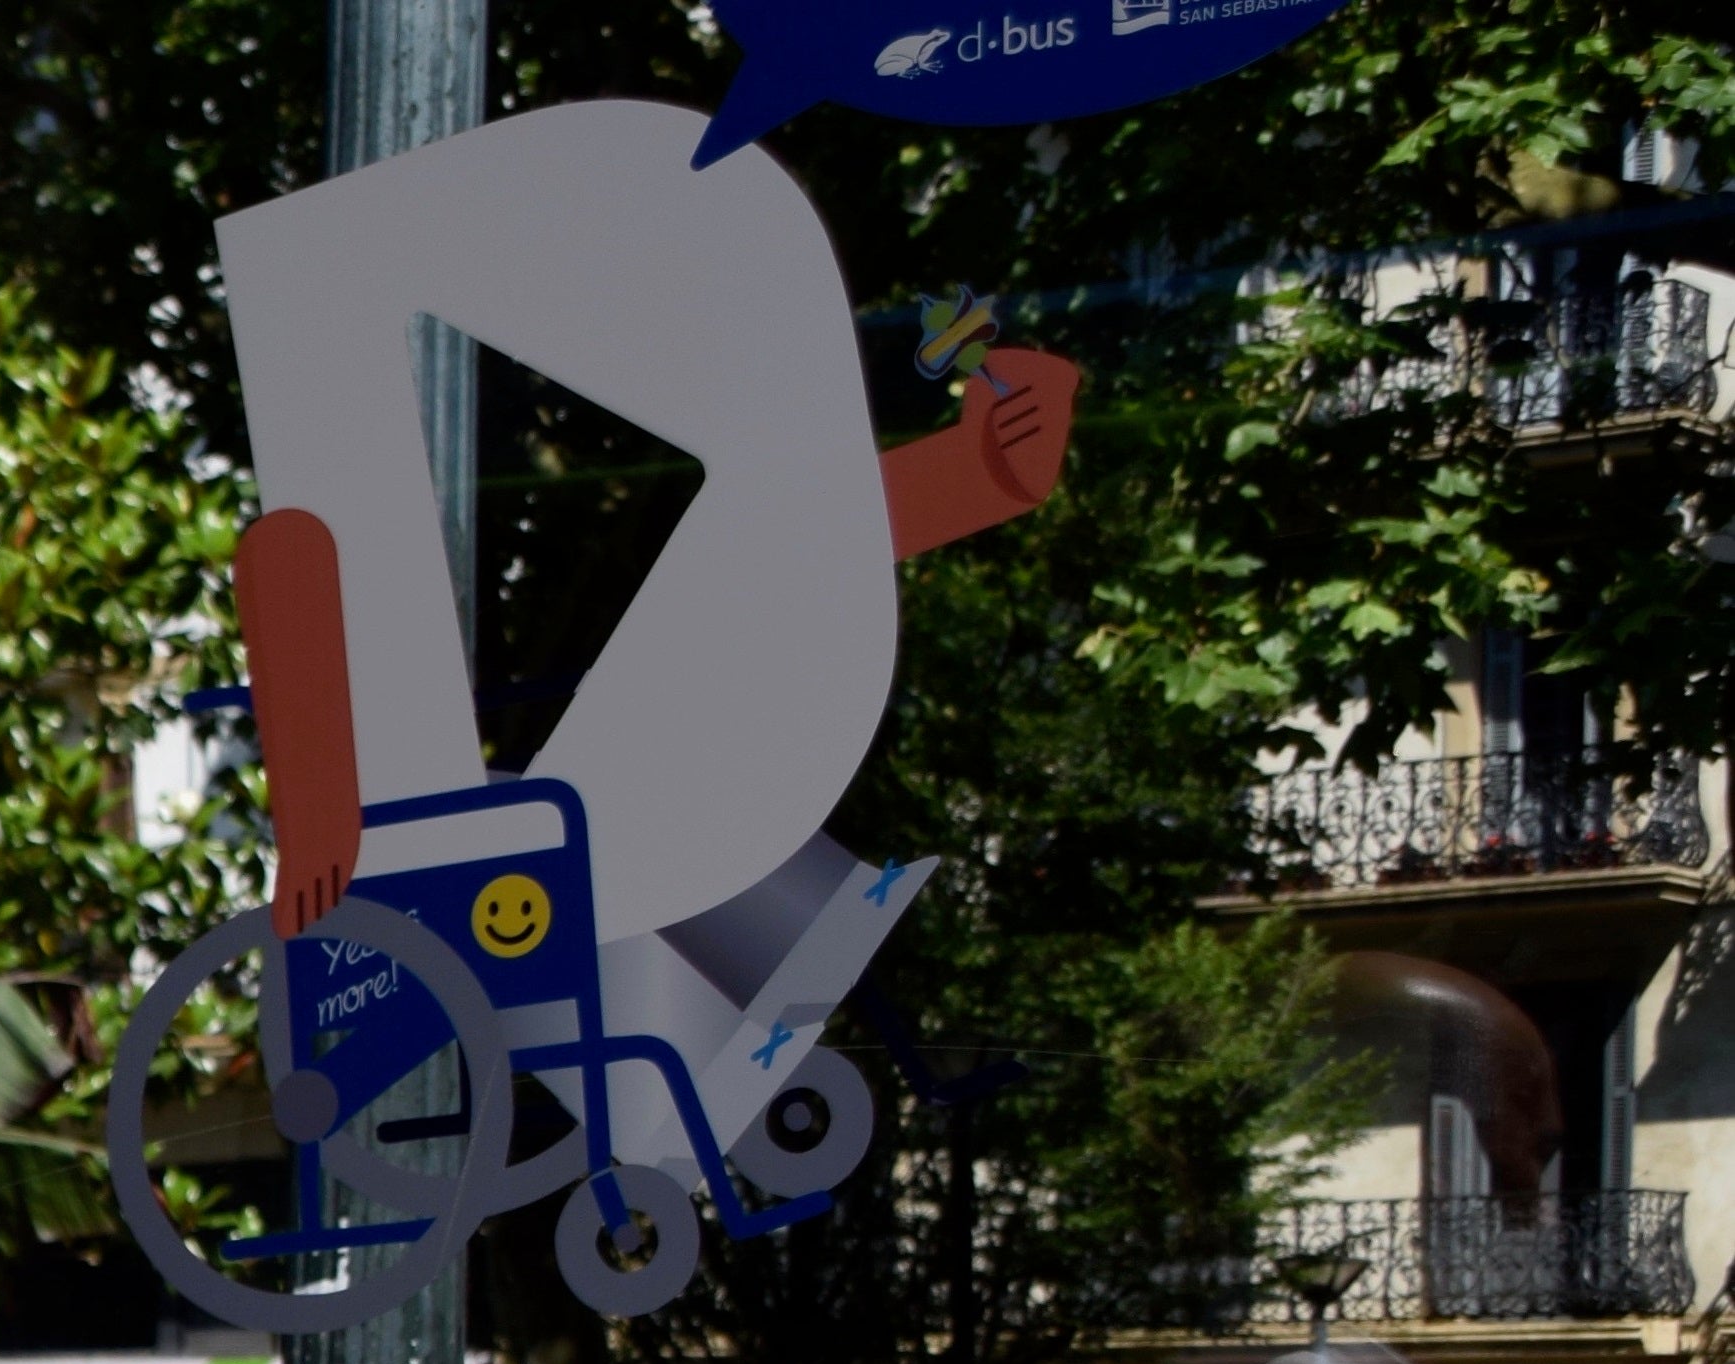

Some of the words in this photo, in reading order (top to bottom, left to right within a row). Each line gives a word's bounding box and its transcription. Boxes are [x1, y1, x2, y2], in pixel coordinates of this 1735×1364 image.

[1179, 6, 1215, 26] SAN
[1220, 0, 1320, 19] SEBAS
[317, 959, 399, 1027] more!
